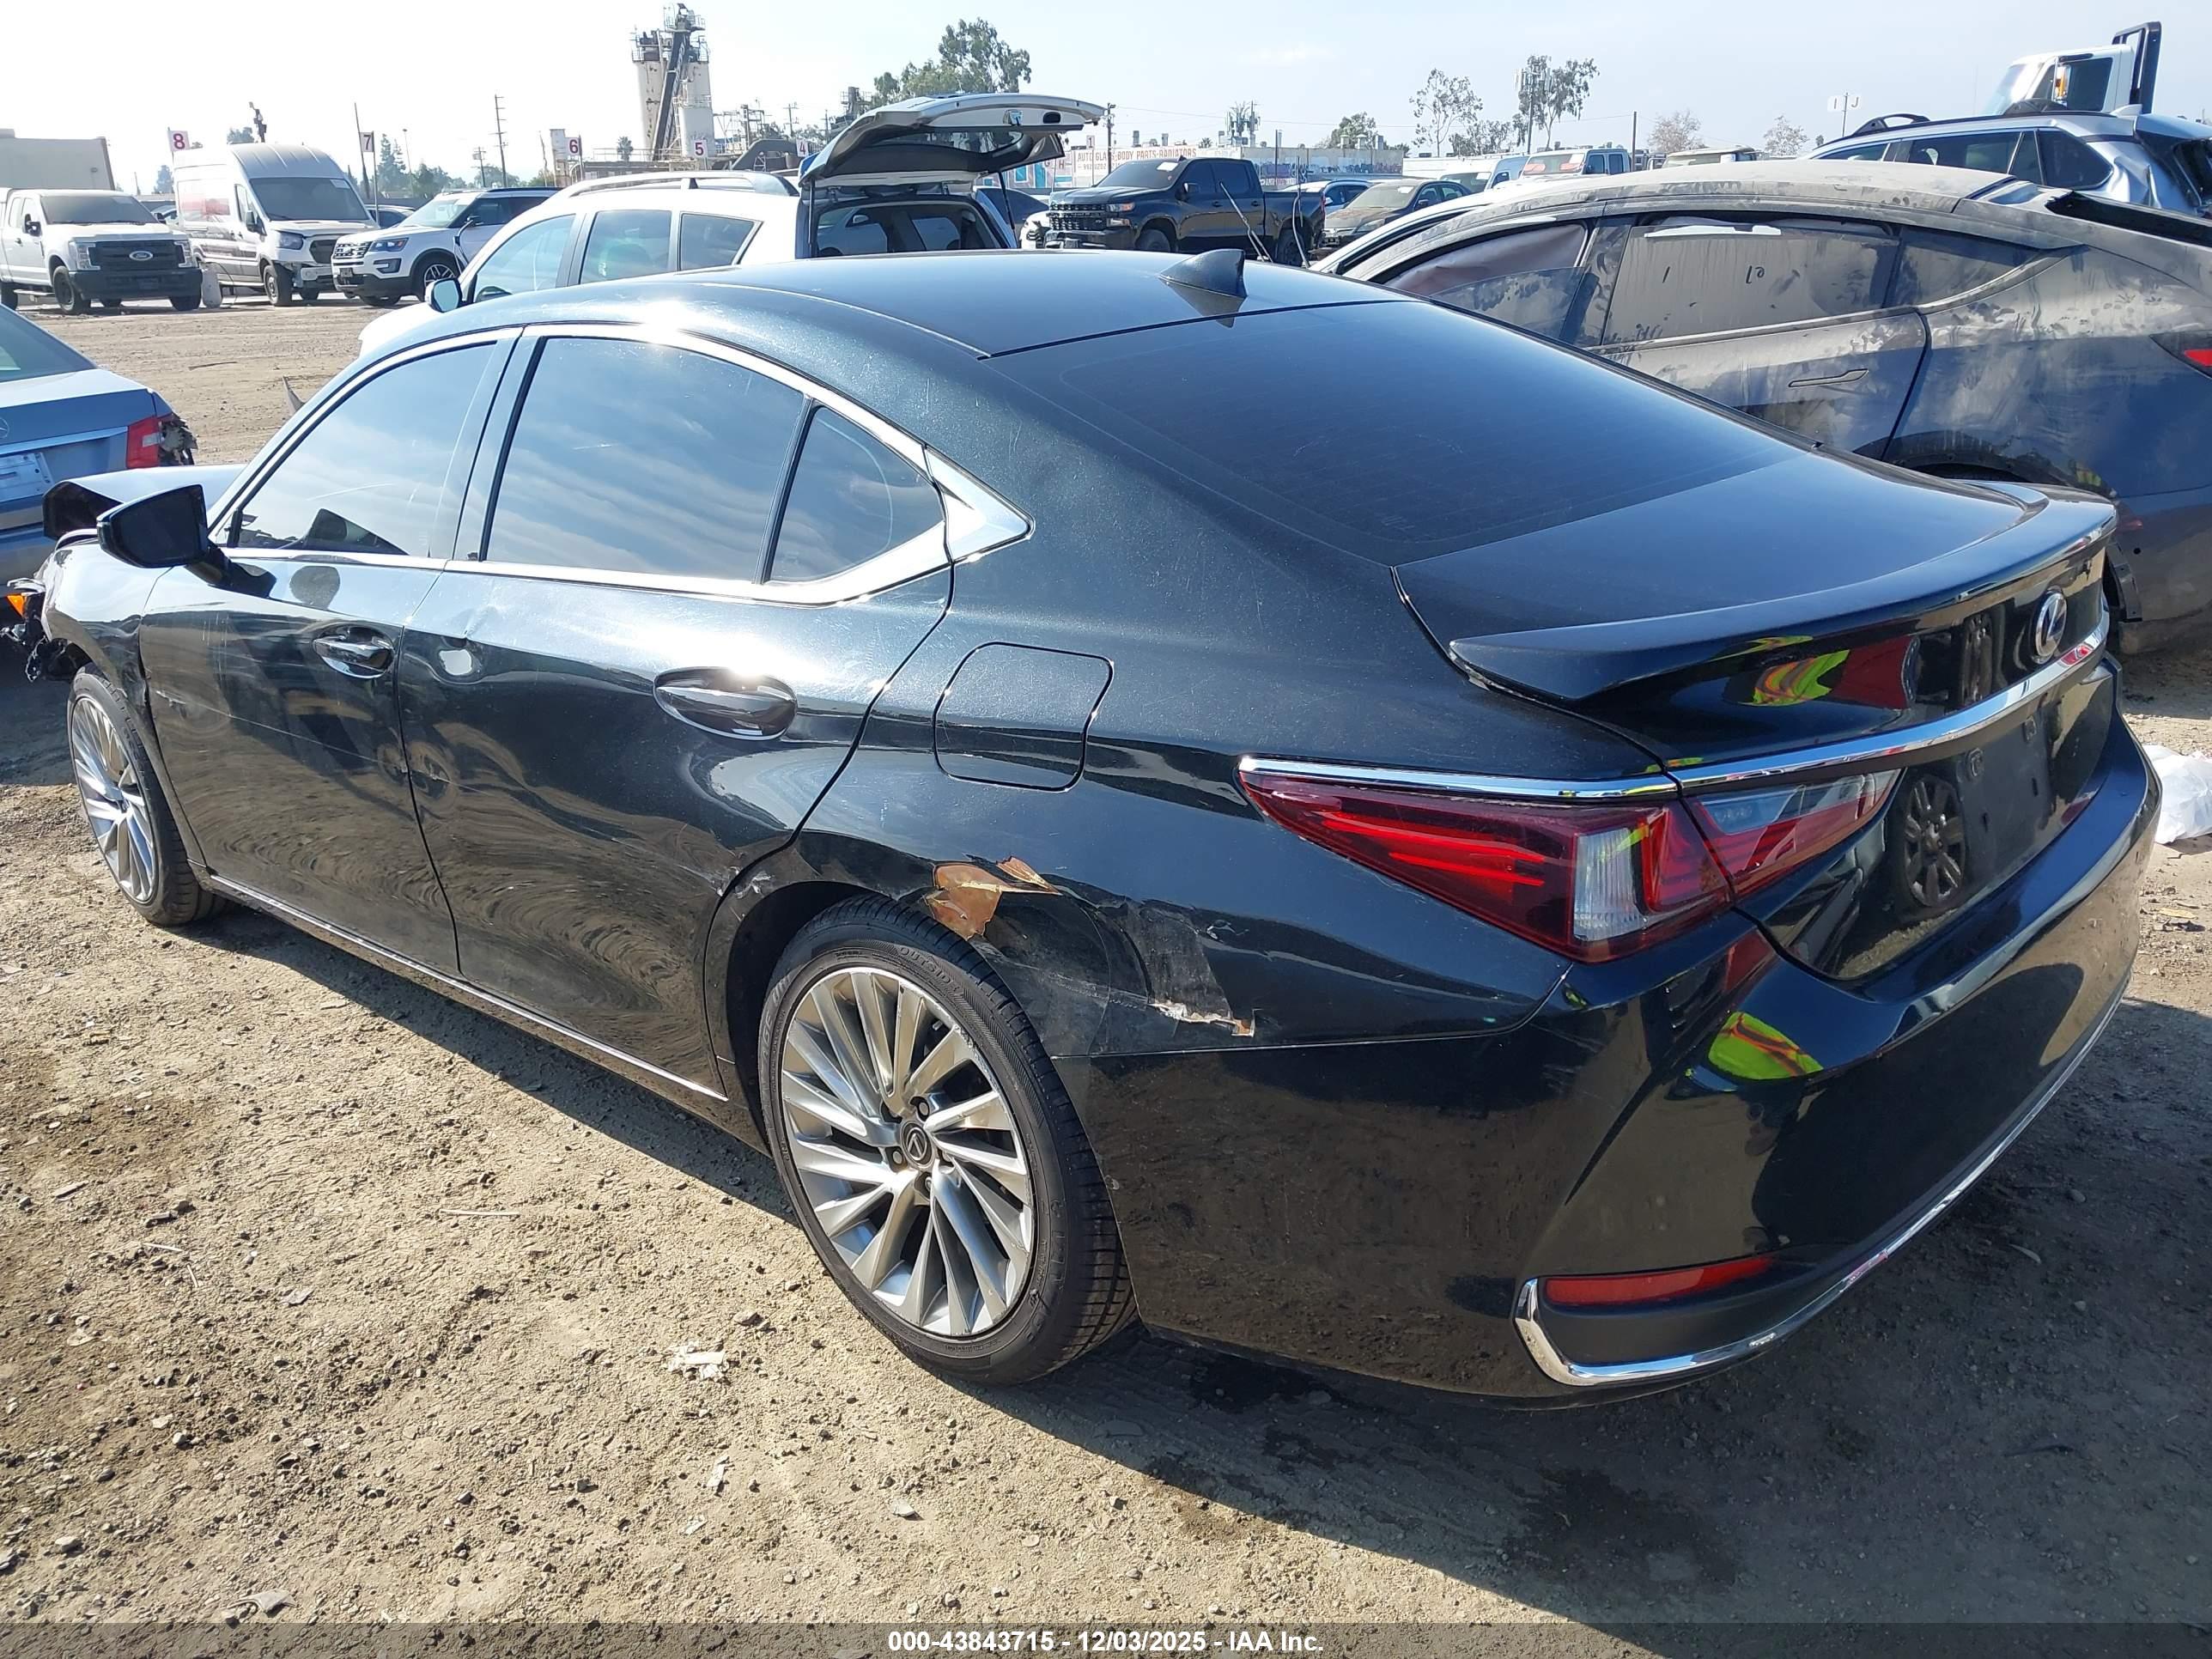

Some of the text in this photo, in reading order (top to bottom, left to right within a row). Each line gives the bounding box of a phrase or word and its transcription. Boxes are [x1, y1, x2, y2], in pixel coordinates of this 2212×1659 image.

[173, 133, 185, 150] 8
[362, 134, 372, 150] 7
[569, 138, 579, 154] 6
[799, 141, 807, 155] 4
[1088, 137, 1093, 149] 1
[695, 142, 704, 156] 5
[1059, 159, 1065, 169] H
